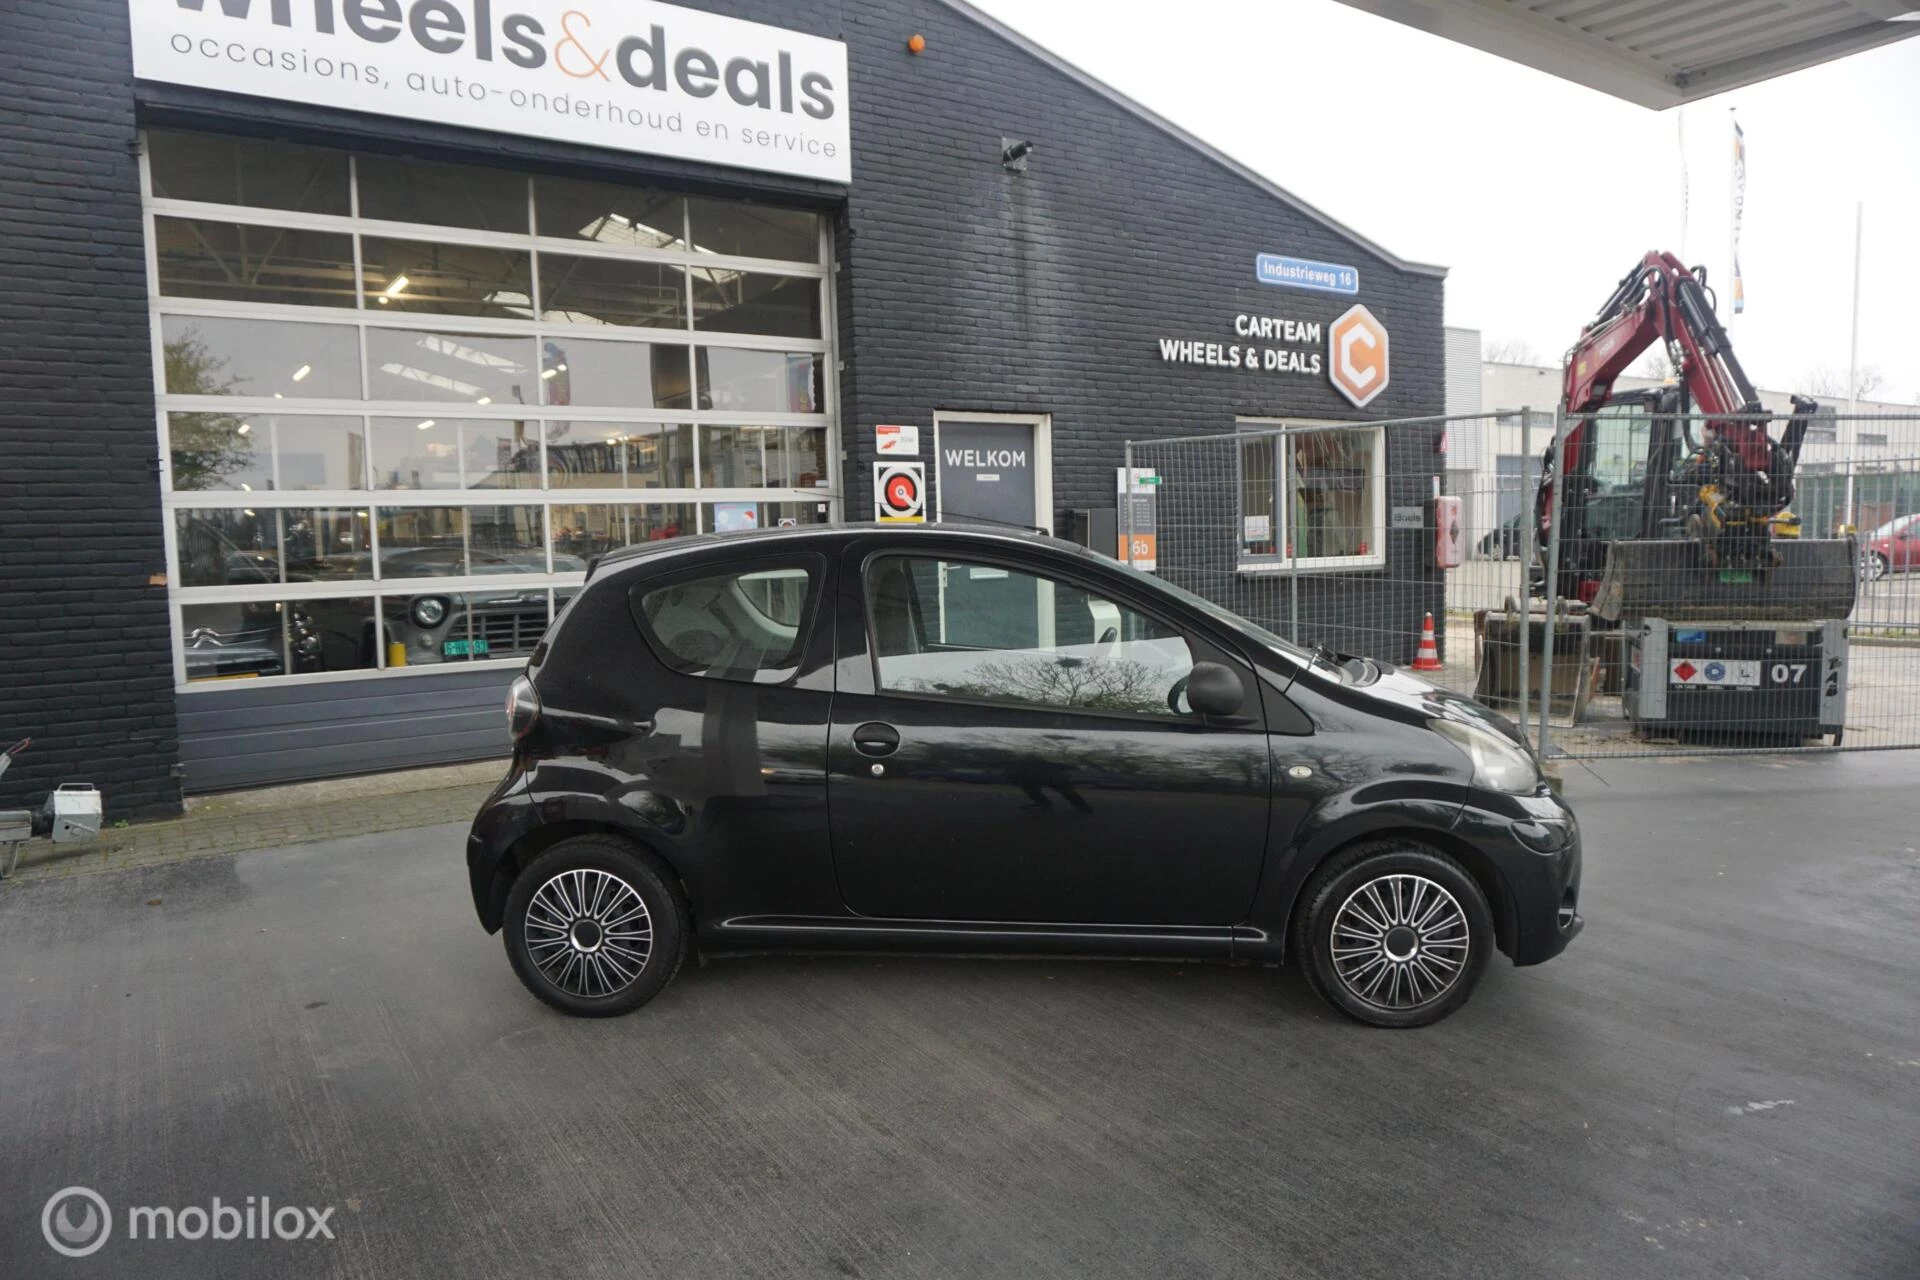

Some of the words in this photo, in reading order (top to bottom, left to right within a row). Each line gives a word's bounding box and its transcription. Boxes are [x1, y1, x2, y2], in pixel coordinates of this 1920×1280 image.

[170, 34, 390, 90] occasions,
[406, 72, 682, 132] auto-onderhoud
[696, 119, 729, 140] en
[742, 127, 837, 158] service
[1264, 261, 1336, 286] Industrieweg
[1339, 271, 1352, 286] 16
[1235, 315, 1321, 342] CARTEAM
[1159, 338, 1240, 365] WHEELS
[1245, 348, 1259, 369] &
[1265, 349, 1321, 374] DEALS
[945, 449, 1025, 467] WELKOM
[1771, 664, 1807, 684] 07
